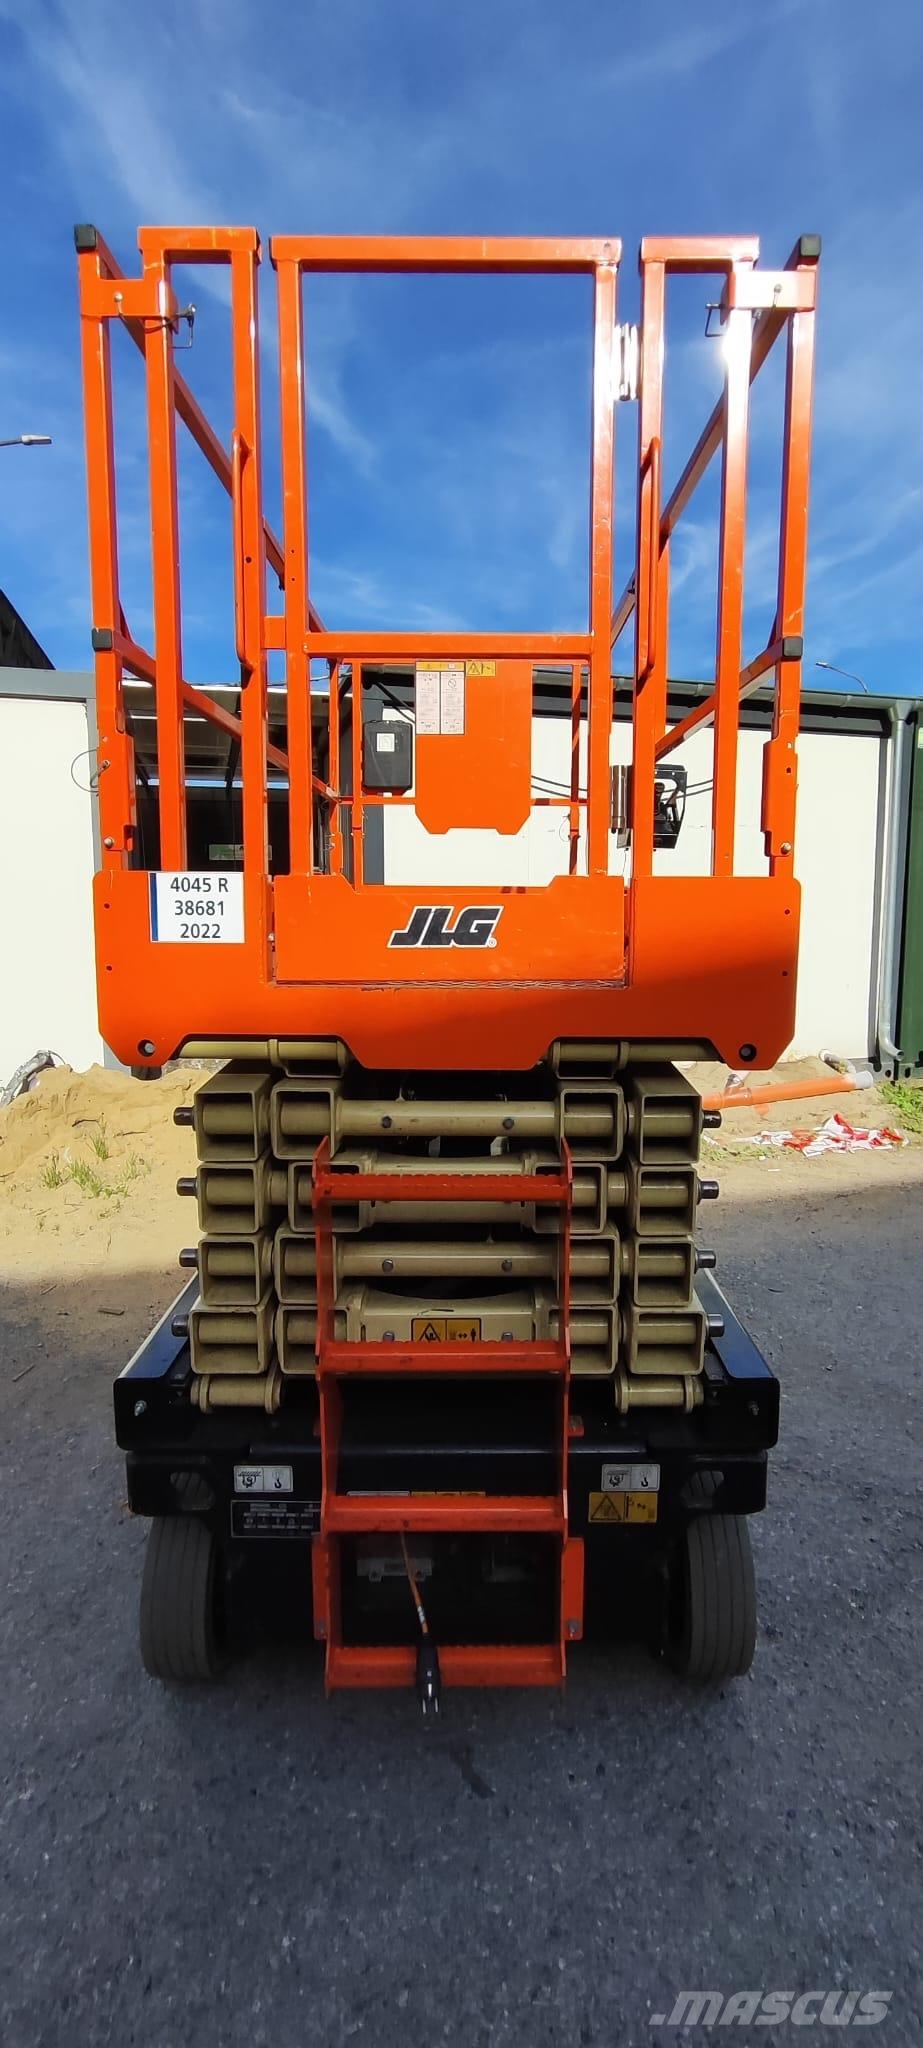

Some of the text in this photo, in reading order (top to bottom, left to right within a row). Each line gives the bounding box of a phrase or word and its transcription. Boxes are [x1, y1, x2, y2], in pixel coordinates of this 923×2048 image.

[170, 877, 229, 893] 4045 R
[174, 900, 224, 916] 38681
[180, 923, 221, 939] 2022
[388, 906, 503, 947] JLG
